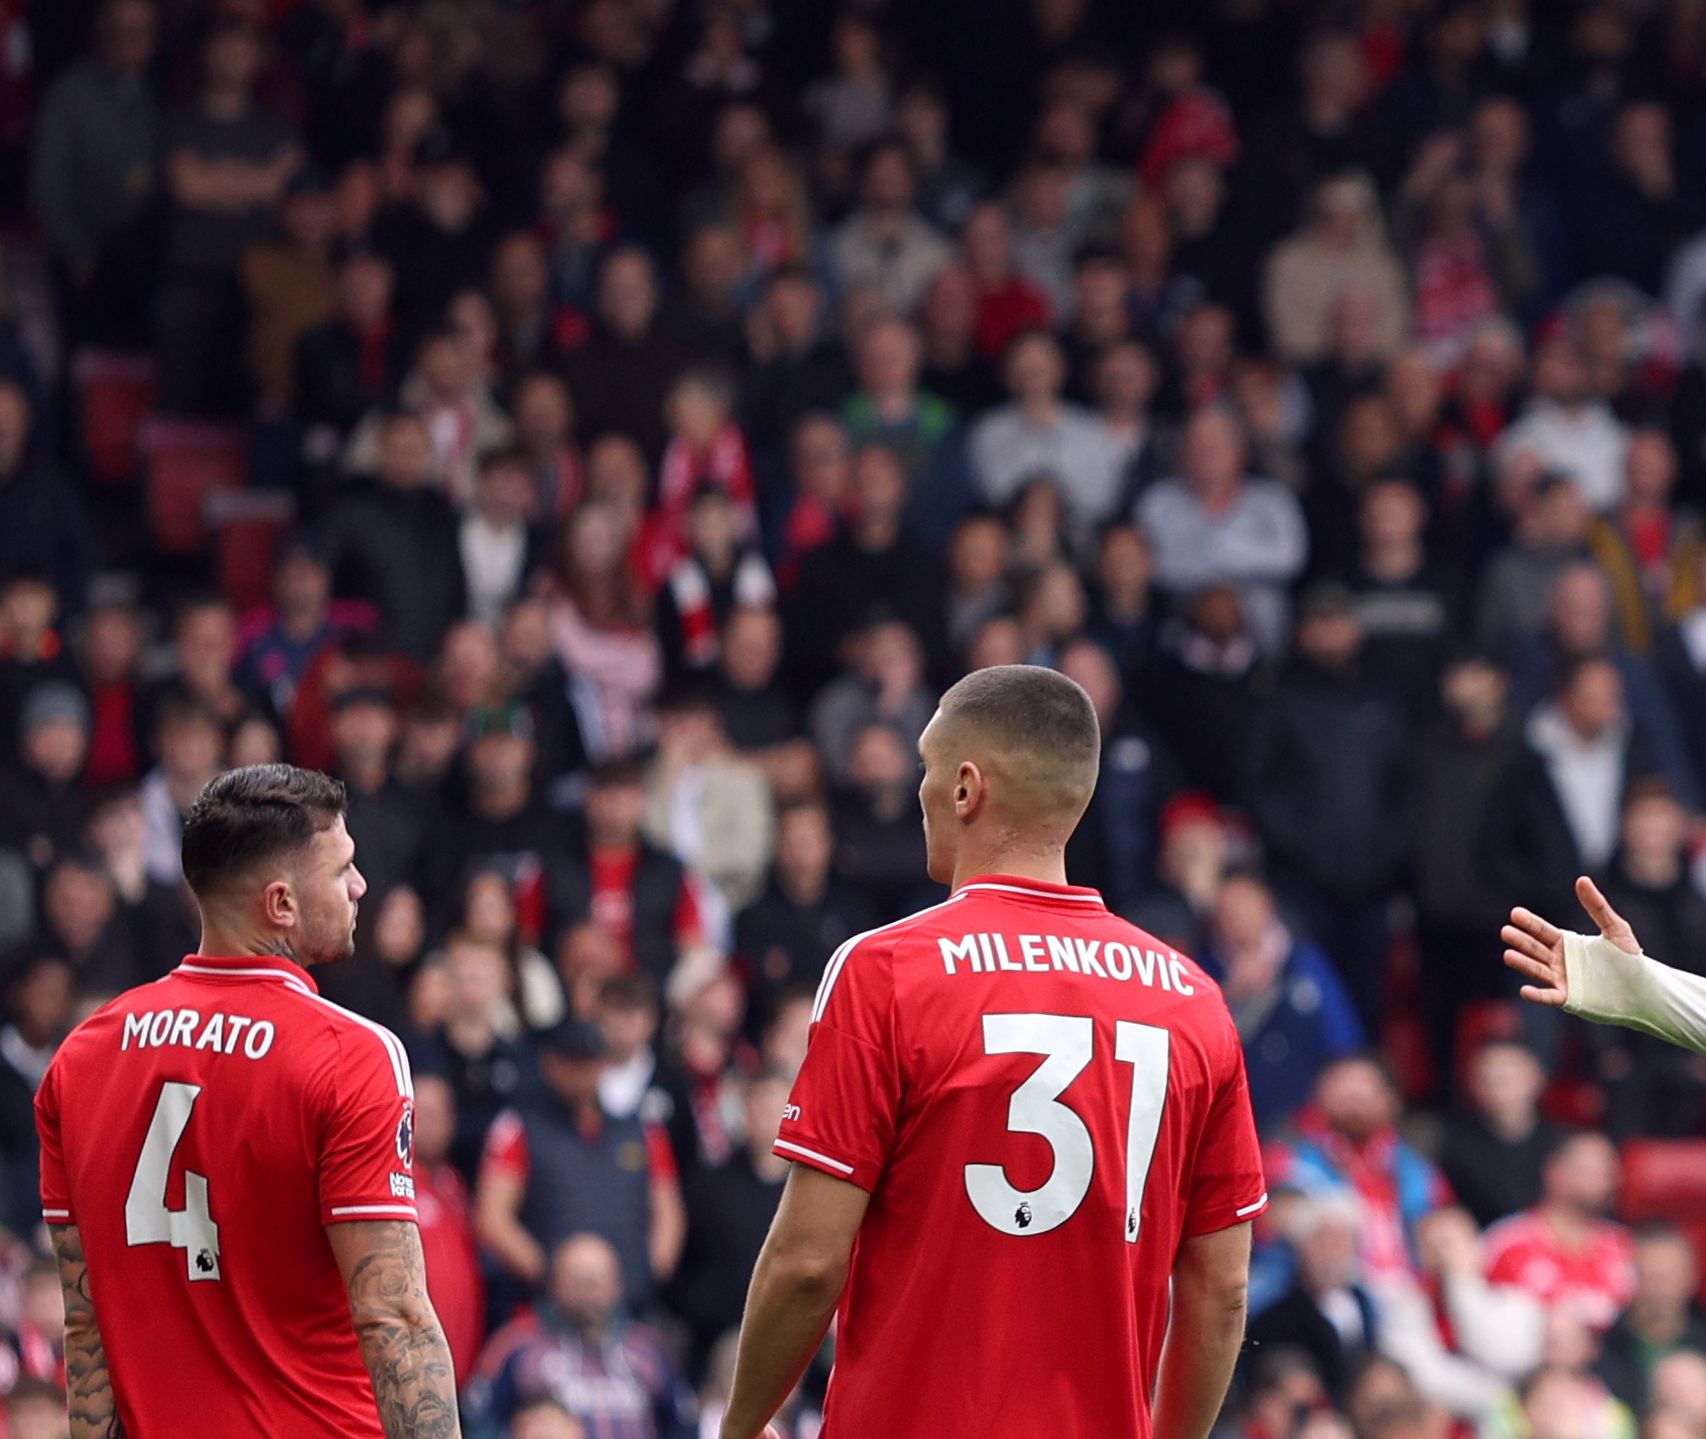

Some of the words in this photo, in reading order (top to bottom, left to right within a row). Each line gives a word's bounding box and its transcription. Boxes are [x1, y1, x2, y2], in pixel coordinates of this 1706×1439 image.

[938, 932, 1195, 996] MILENKOVIĆ
[121, 1009, 275, 1060] MORATO
[126, 1081, 220, 1281] 4
[965, 1012, 1170, 1243] 31
